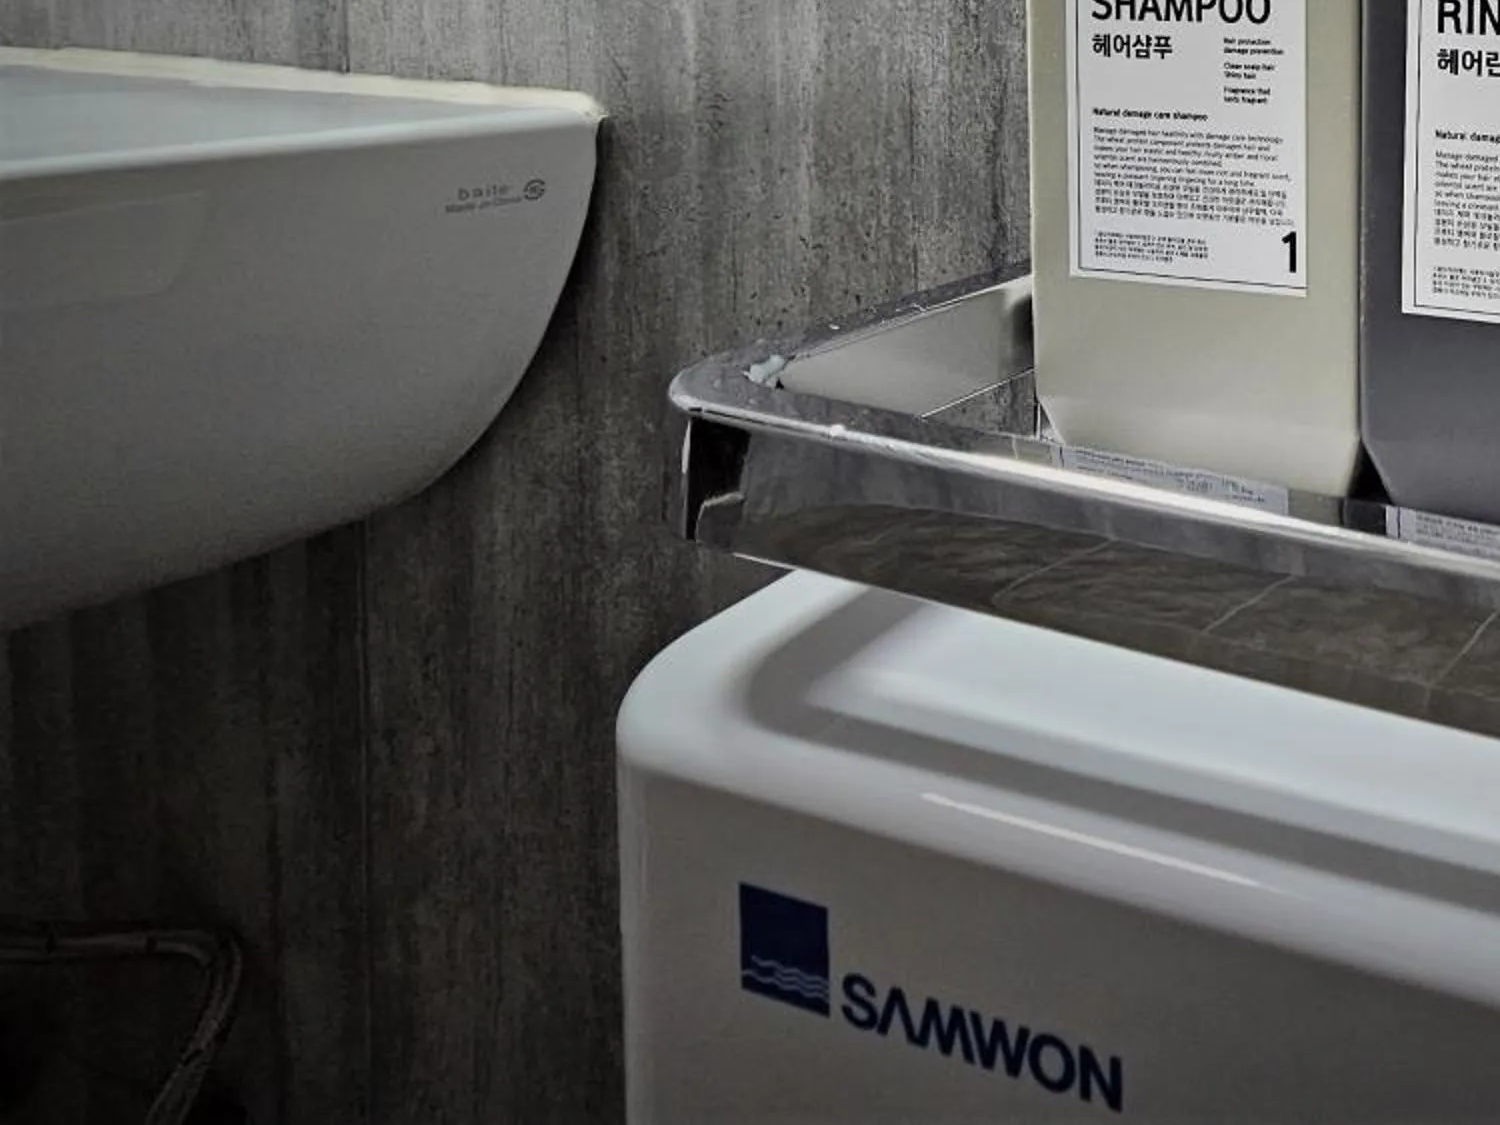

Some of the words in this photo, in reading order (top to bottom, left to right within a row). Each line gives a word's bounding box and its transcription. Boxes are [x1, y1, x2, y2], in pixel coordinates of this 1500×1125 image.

[1092, 34, 1173, 59] 헤어샴푸
[1281, 231, 1298, 273] 1
[840, 973, 1123, 1113] SAMWON
